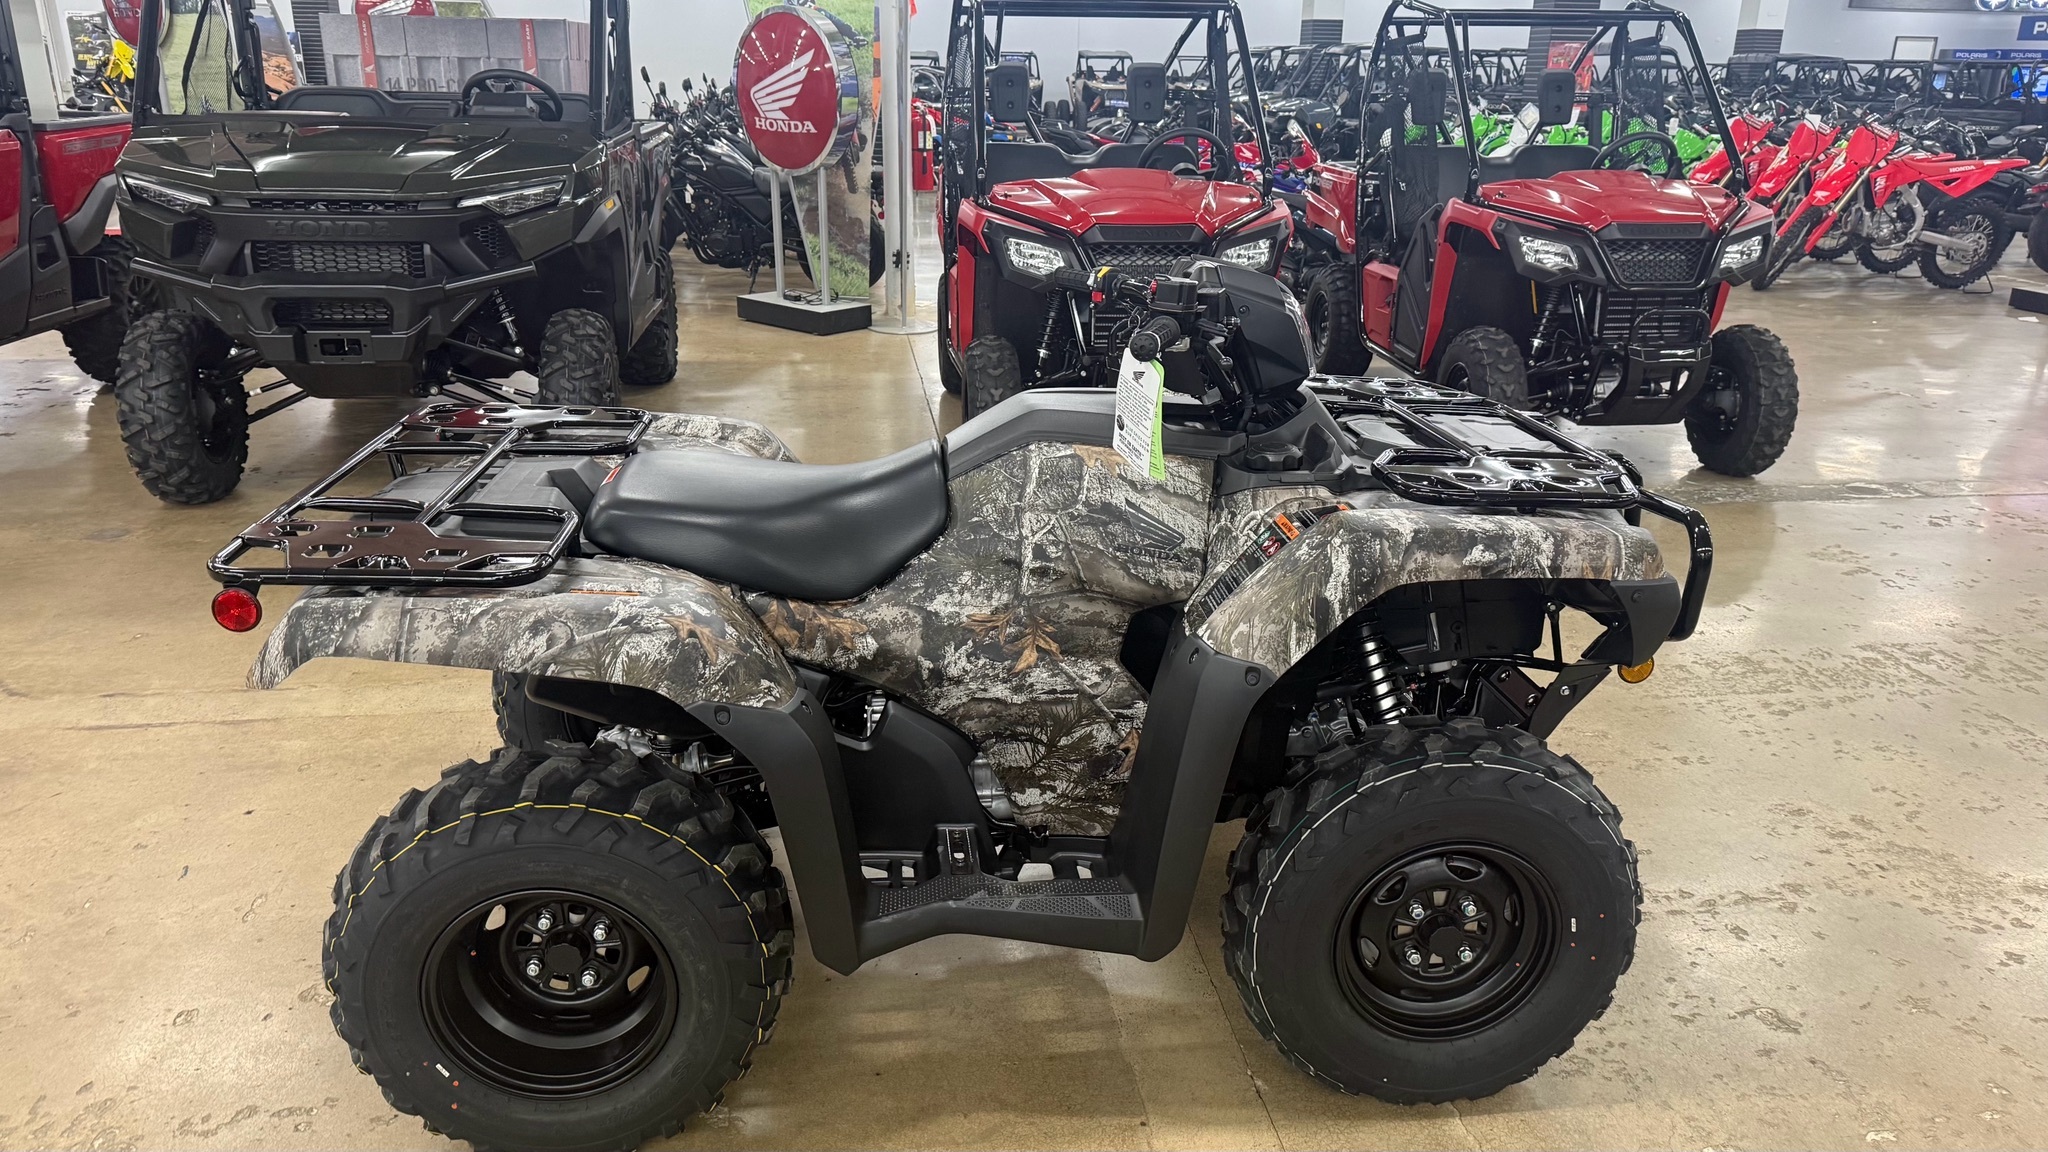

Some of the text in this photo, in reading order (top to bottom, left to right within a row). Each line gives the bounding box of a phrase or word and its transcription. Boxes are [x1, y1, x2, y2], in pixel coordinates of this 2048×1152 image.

[2032, 21, 2048, 35] P
[385, 77, 403, 91] 14
[754, 116, 818, 133] HONDA
[1949, 165, 1976, 173] HONDA
[265, 220, 403, 238] HONDA
